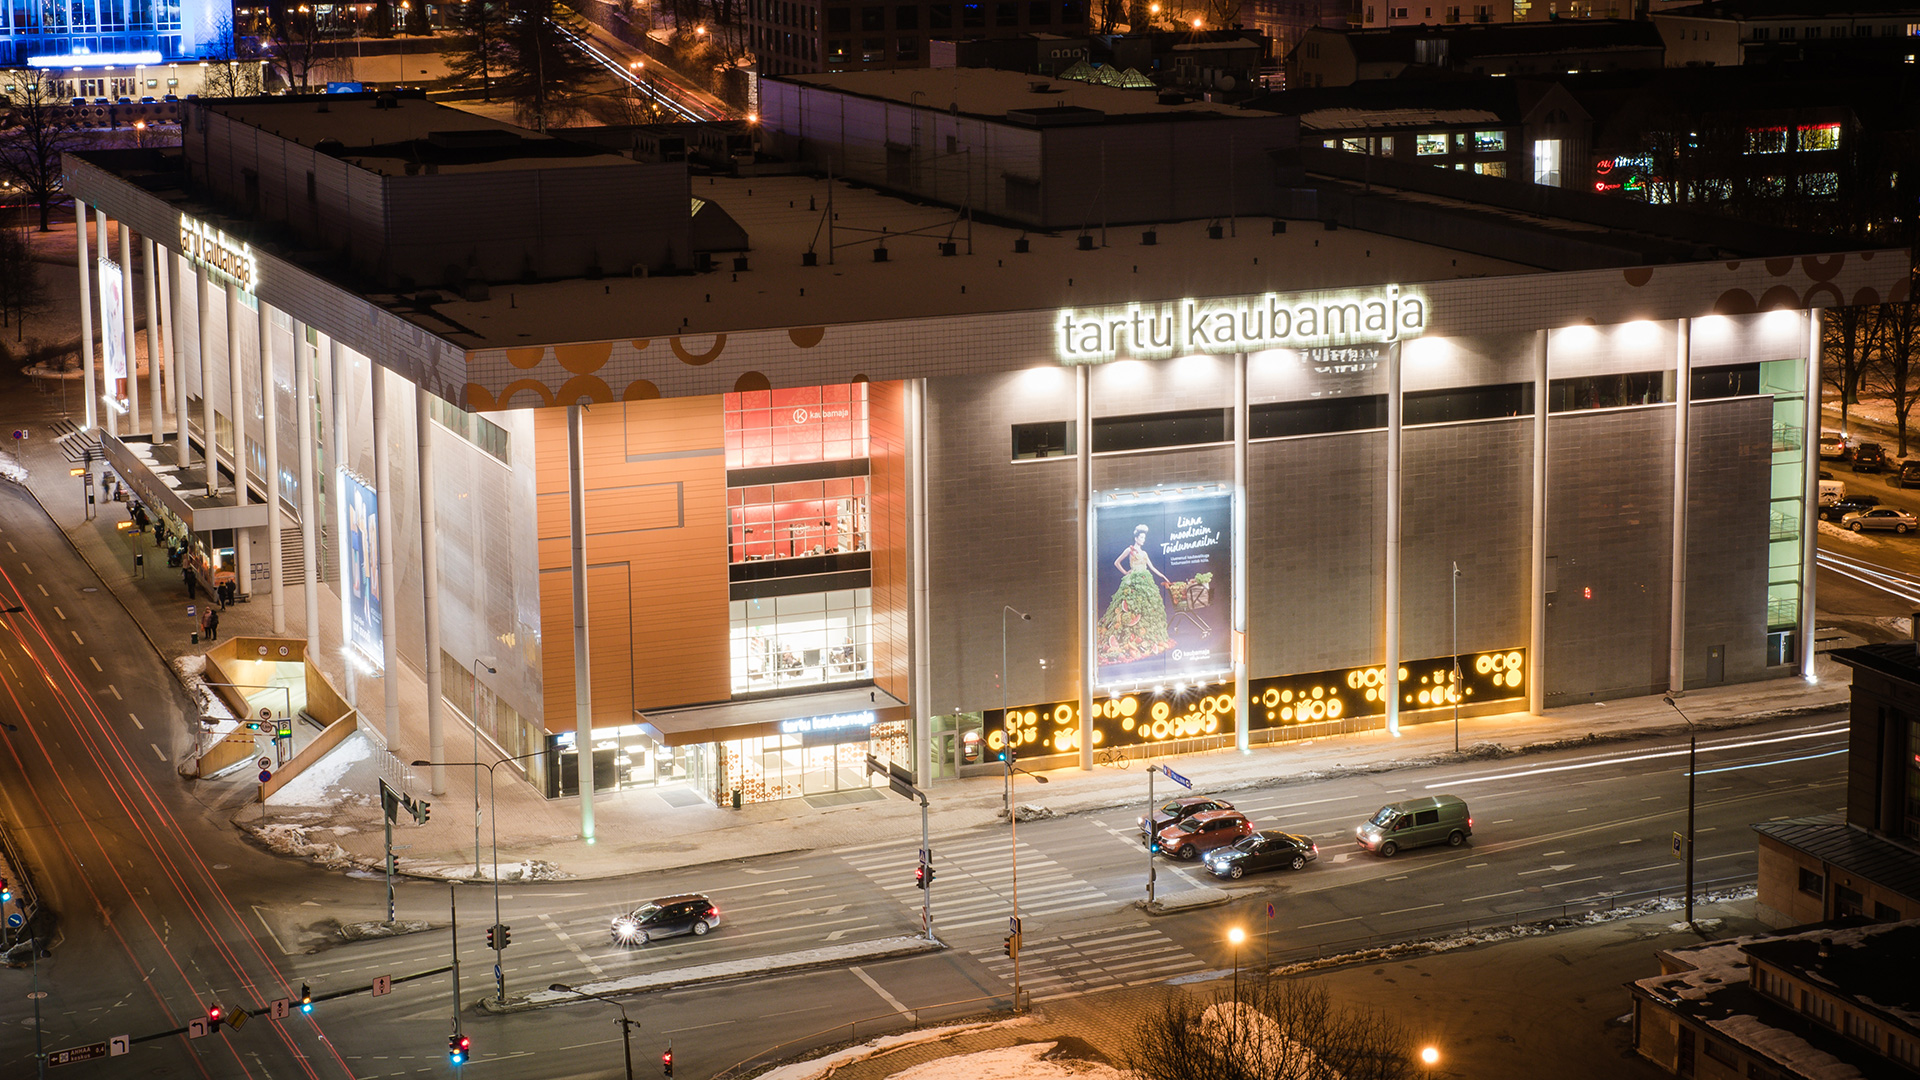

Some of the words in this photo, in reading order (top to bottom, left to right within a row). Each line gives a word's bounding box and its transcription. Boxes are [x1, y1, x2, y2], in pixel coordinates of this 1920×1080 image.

[1062, 309, 1172, 355] tartu
[1187, 287, 1425, 346] kaubamaja
[810, 409, 849, 418] kaubamaja
[1177, 516, 1203, 528] Linna
[1170, 524, 1212, 541] moodsaim
[1160, 531, 1220, 555] Toidumaailm!
[782, 719, 811, 733] tartu
[812, 710, 875, 730] kaubamaja
